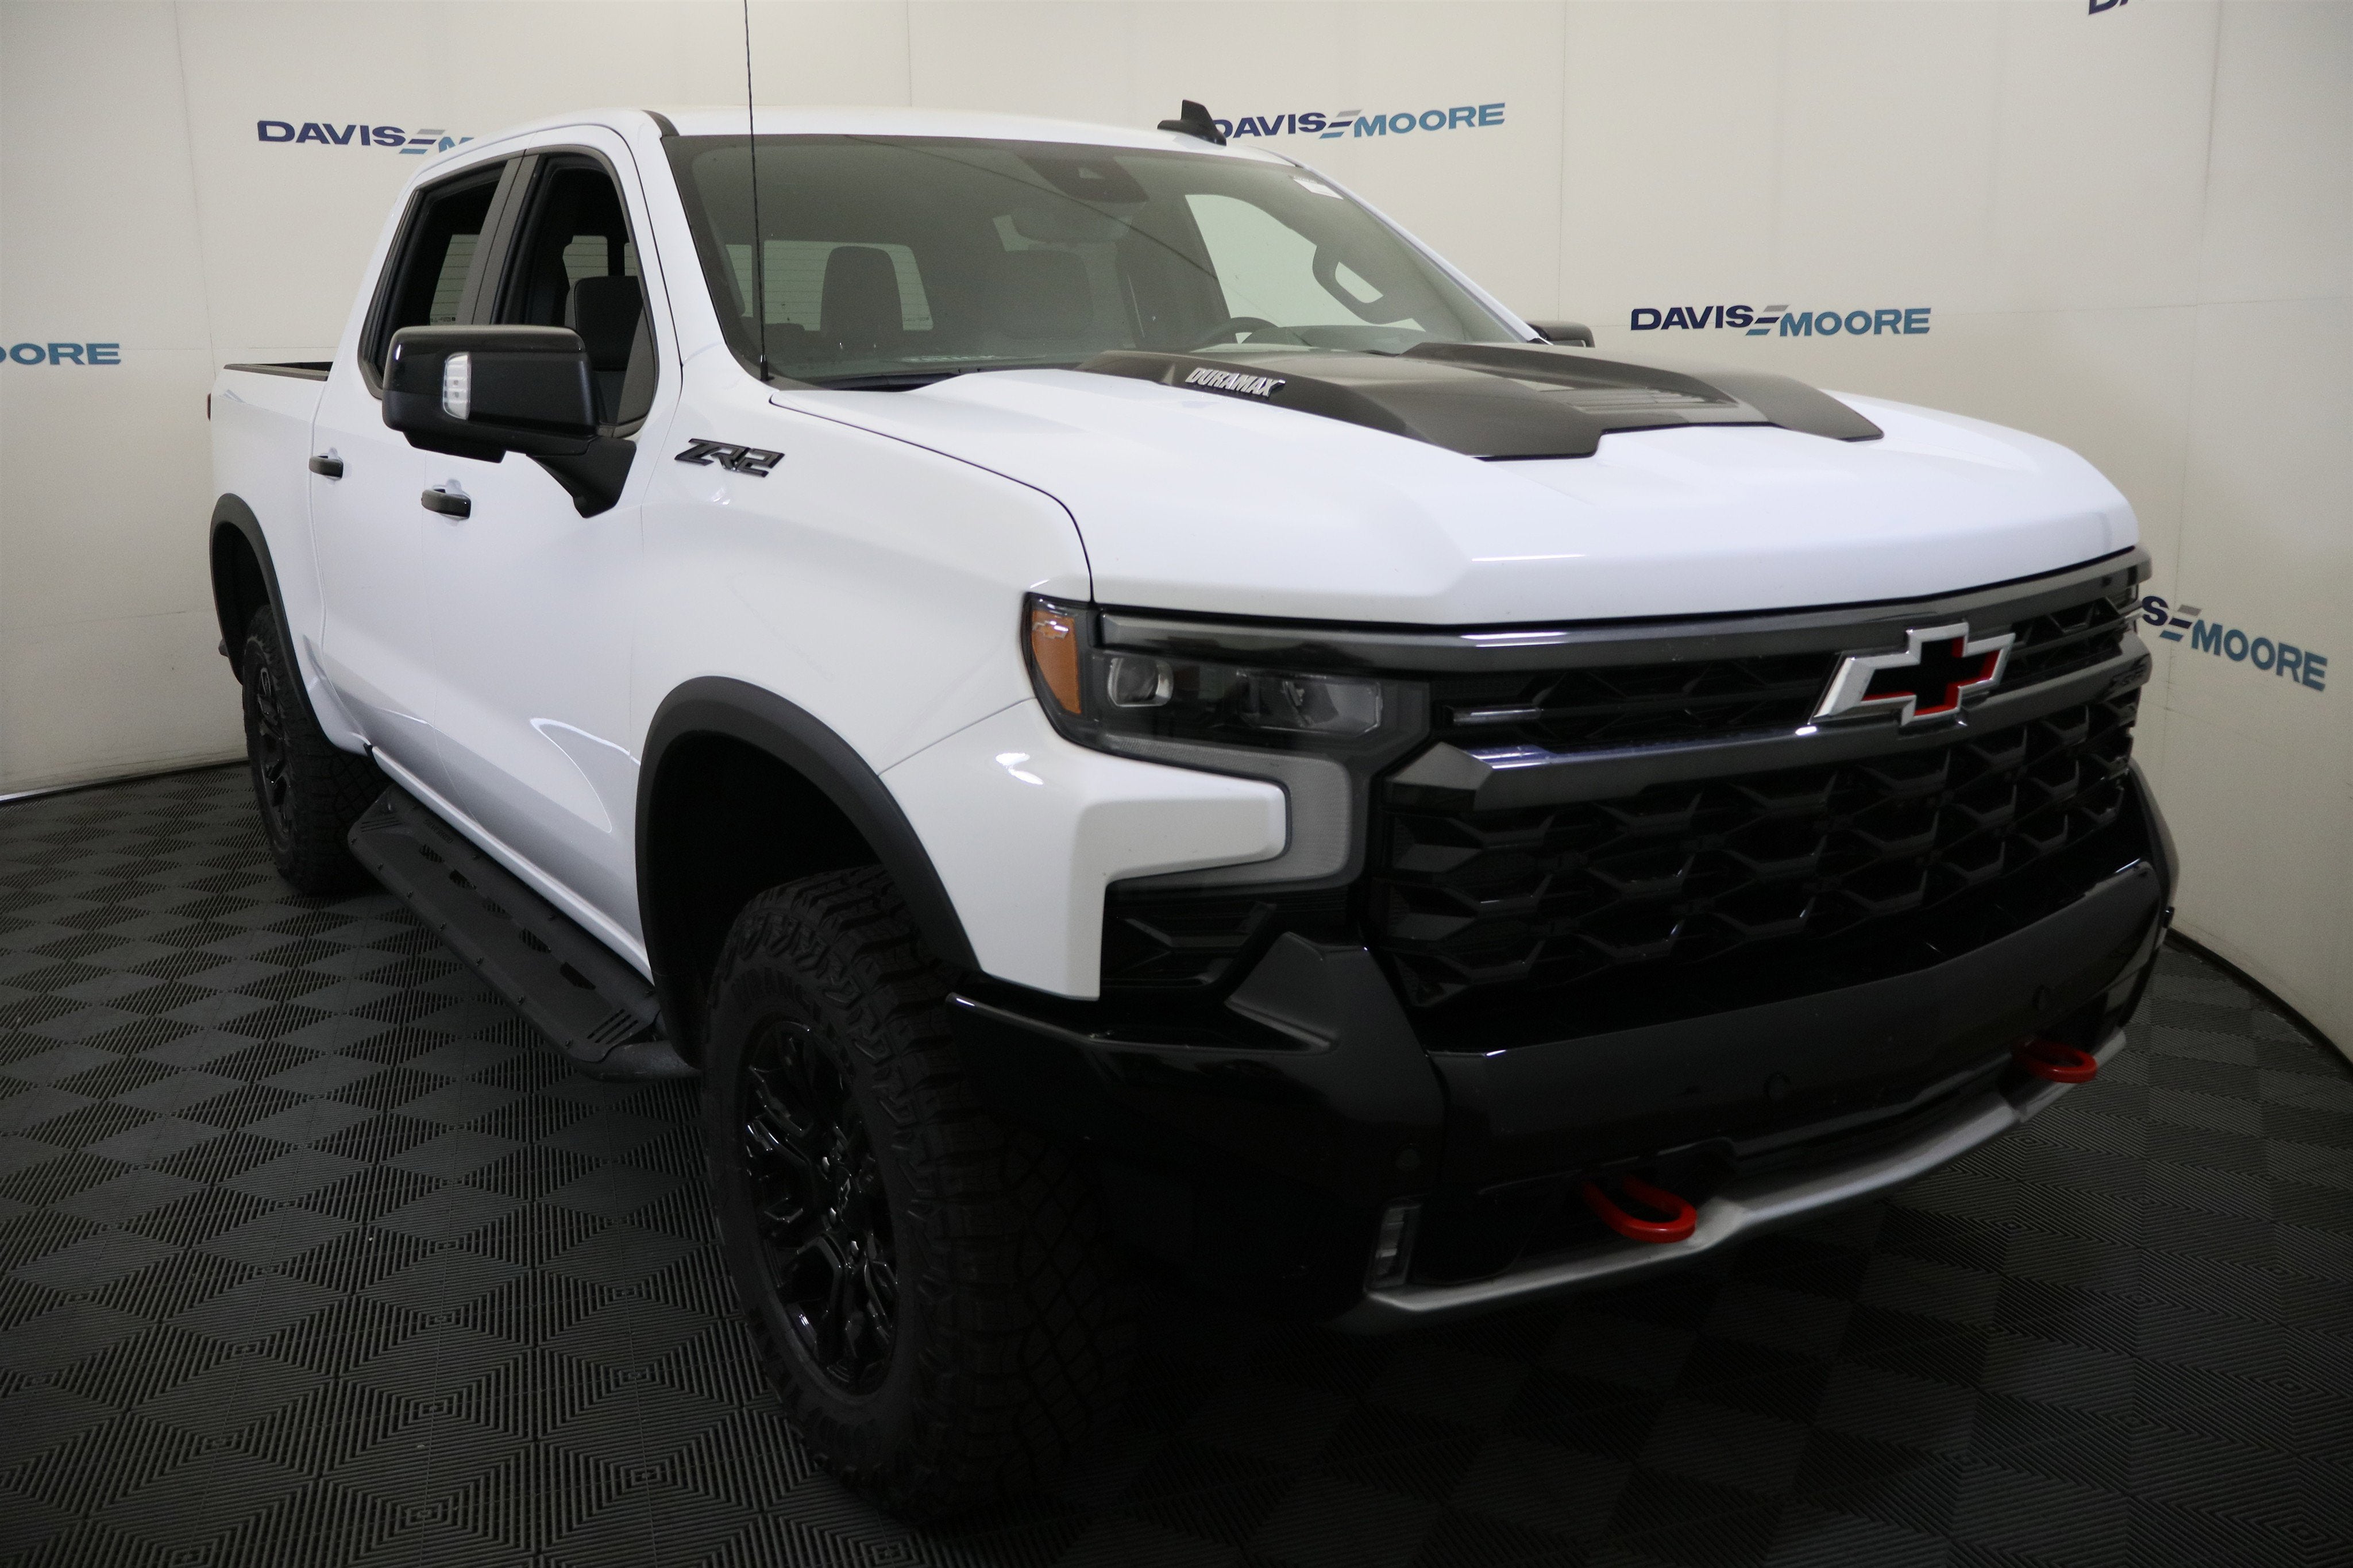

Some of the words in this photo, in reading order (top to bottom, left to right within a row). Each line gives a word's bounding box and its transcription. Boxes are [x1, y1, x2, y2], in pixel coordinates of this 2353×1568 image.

[257, 120, 406, 146] DAVIS
[1211, 112, 1326, 139] DAVIS
[1353, 102, 1506, 138] MOORE
[1630, 304, 1754, 331] DAVIS
[1780, 308, 1931, 337] MOORE
[0, 343, 121, 365] ORE
[1185, 367, 1286, 397] DURAMAX
[674, 438, 785, 478] ZR2
[2191, 619, 2328, 692] MOORE
